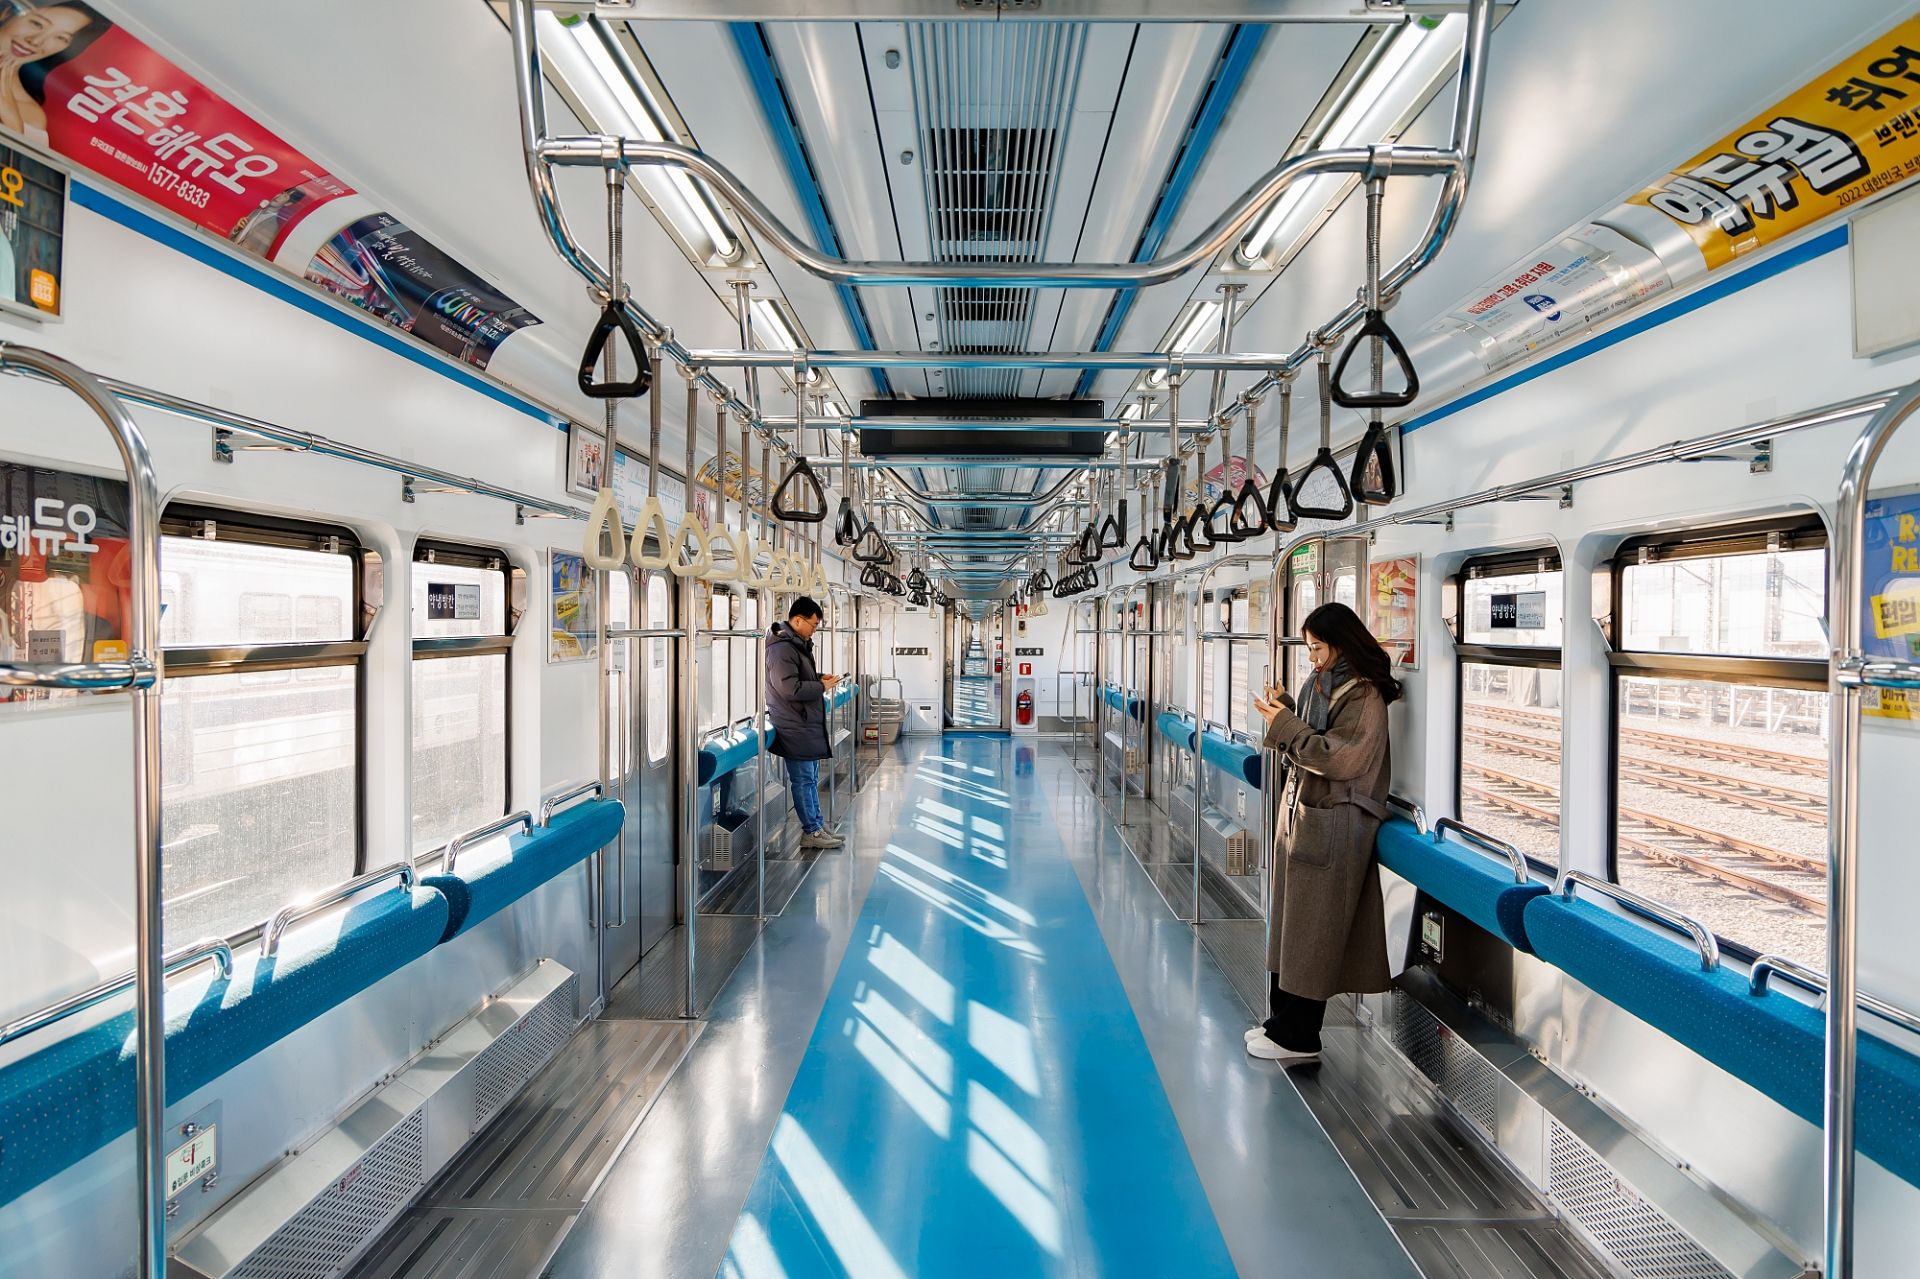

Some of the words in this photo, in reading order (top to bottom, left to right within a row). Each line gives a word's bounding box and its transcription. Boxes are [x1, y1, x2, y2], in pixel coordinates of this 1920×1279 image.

[148, 162, 211, 209] 1577-8333
[1649, 117, 1865, 236] 에듀윌
[1836, 187, 1863, 206] 2022
[1862, 165, 1905, 194] 대한민국
[1529, 261, 1556, 277] 지원
[0, 497, 99, 557] 해듀오
[429, 593, 454, 609] 약냉방칸
[1491, 603, 1516, 619] 약냉방칸
